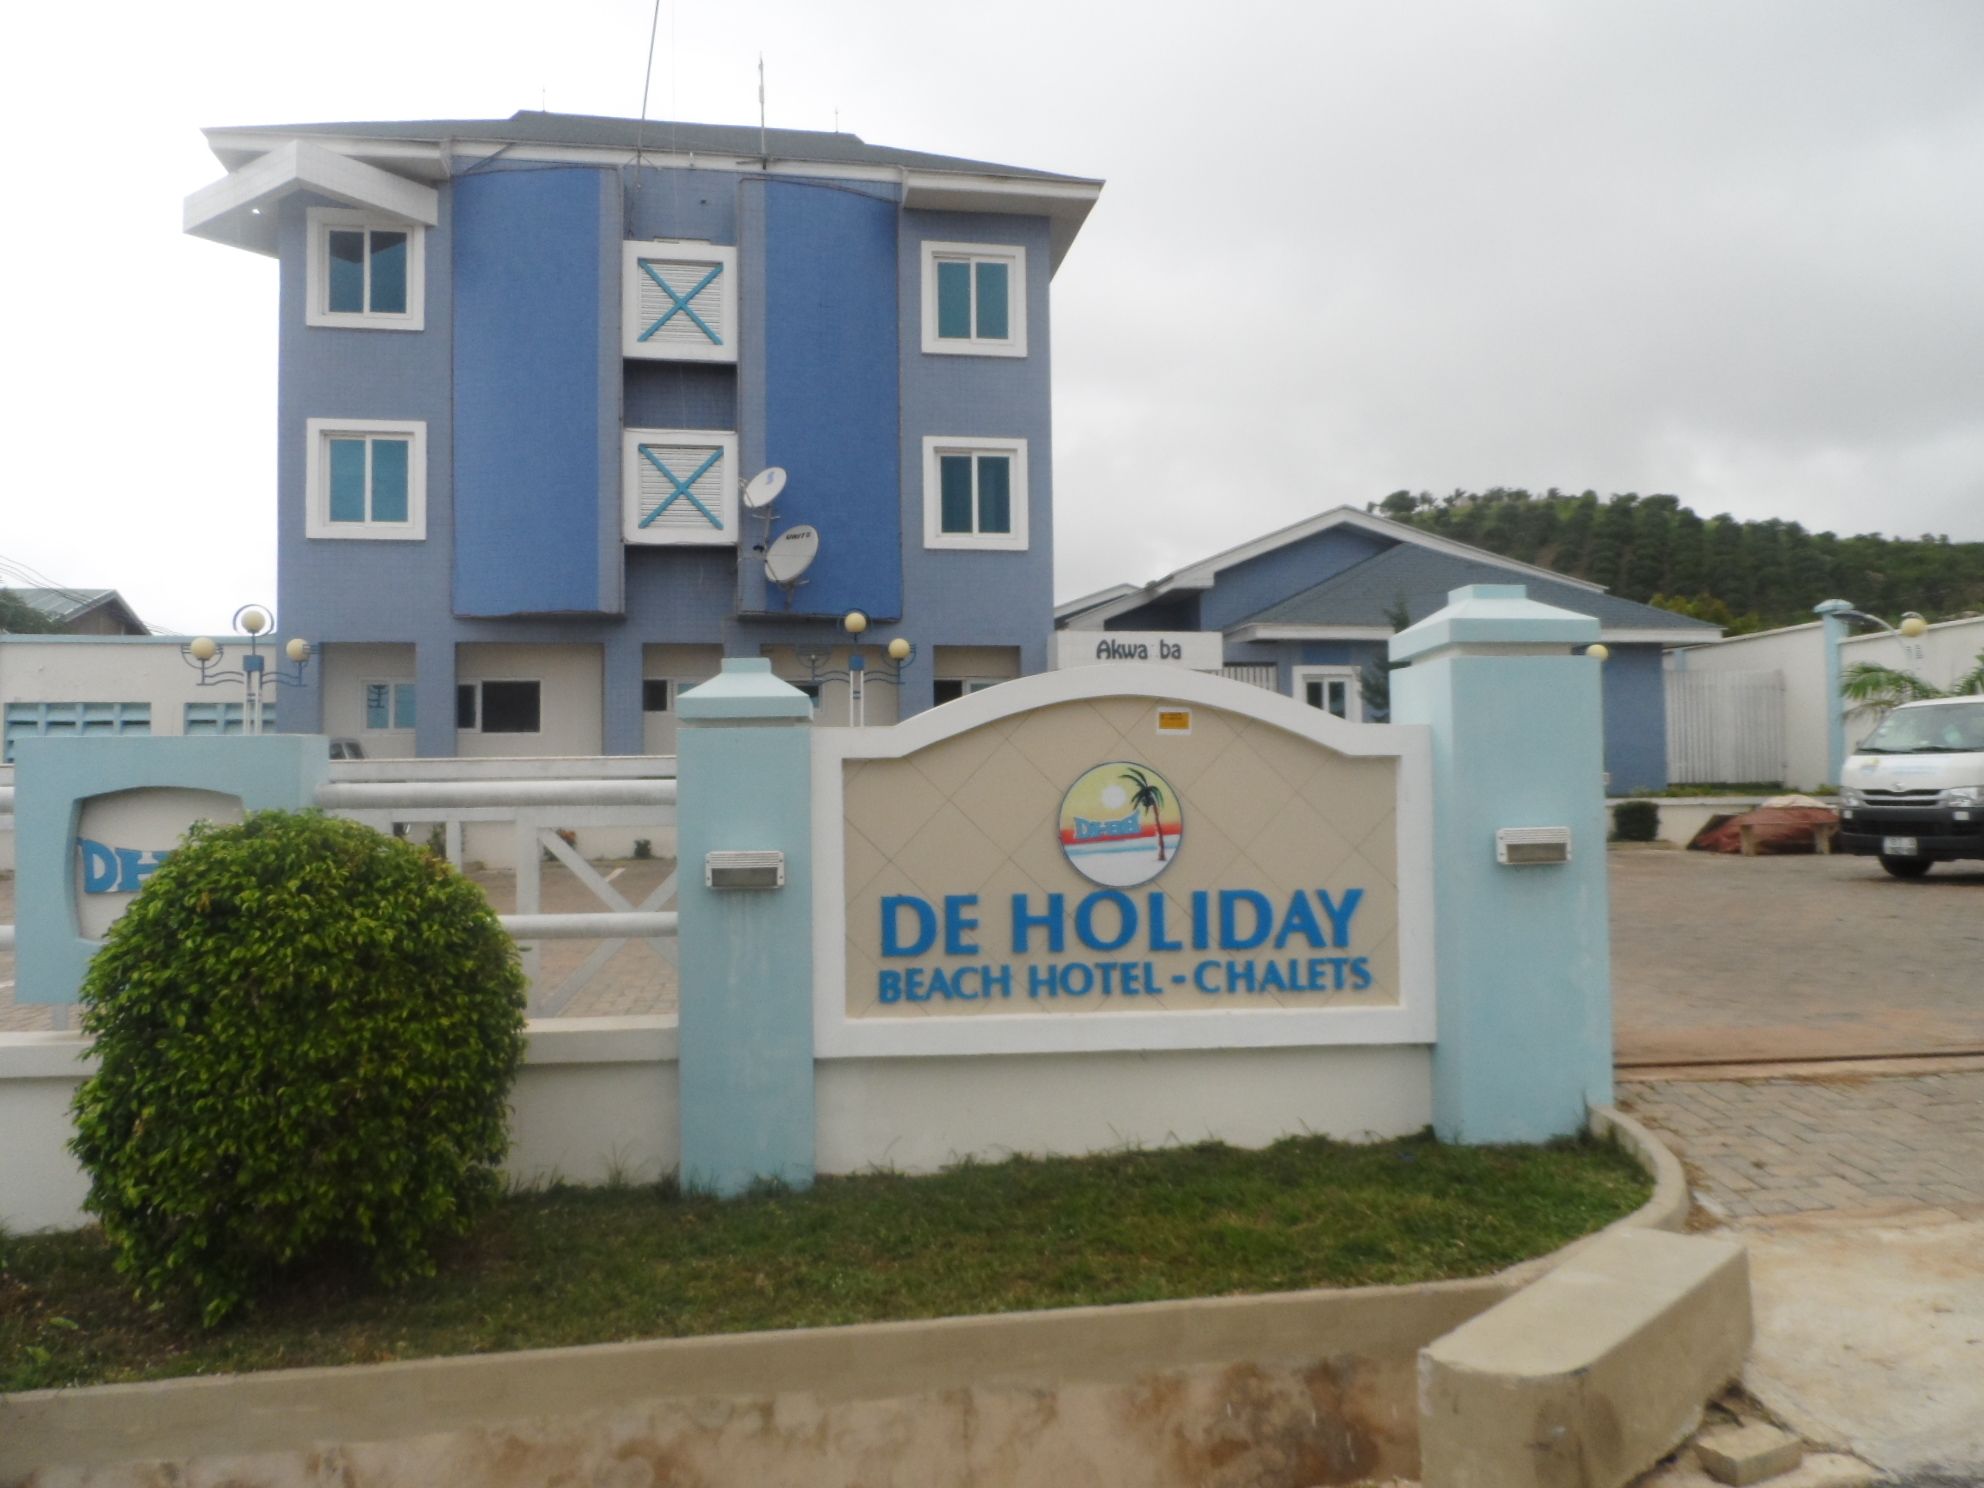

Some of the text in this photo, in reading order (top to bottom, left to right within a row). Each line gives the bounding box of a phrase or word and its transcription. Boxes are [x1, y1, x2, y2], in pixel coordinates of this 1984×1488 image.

[1096, 639, 1182, 660] Akwa ba
[880, 888, 1365, 957] DE HOLIDAY
[878, 964, 1011, 1004] BEACH
[1028, 961, 1163, 998] HOTEL
[1193, 956, 1372, 993] CHALETS
